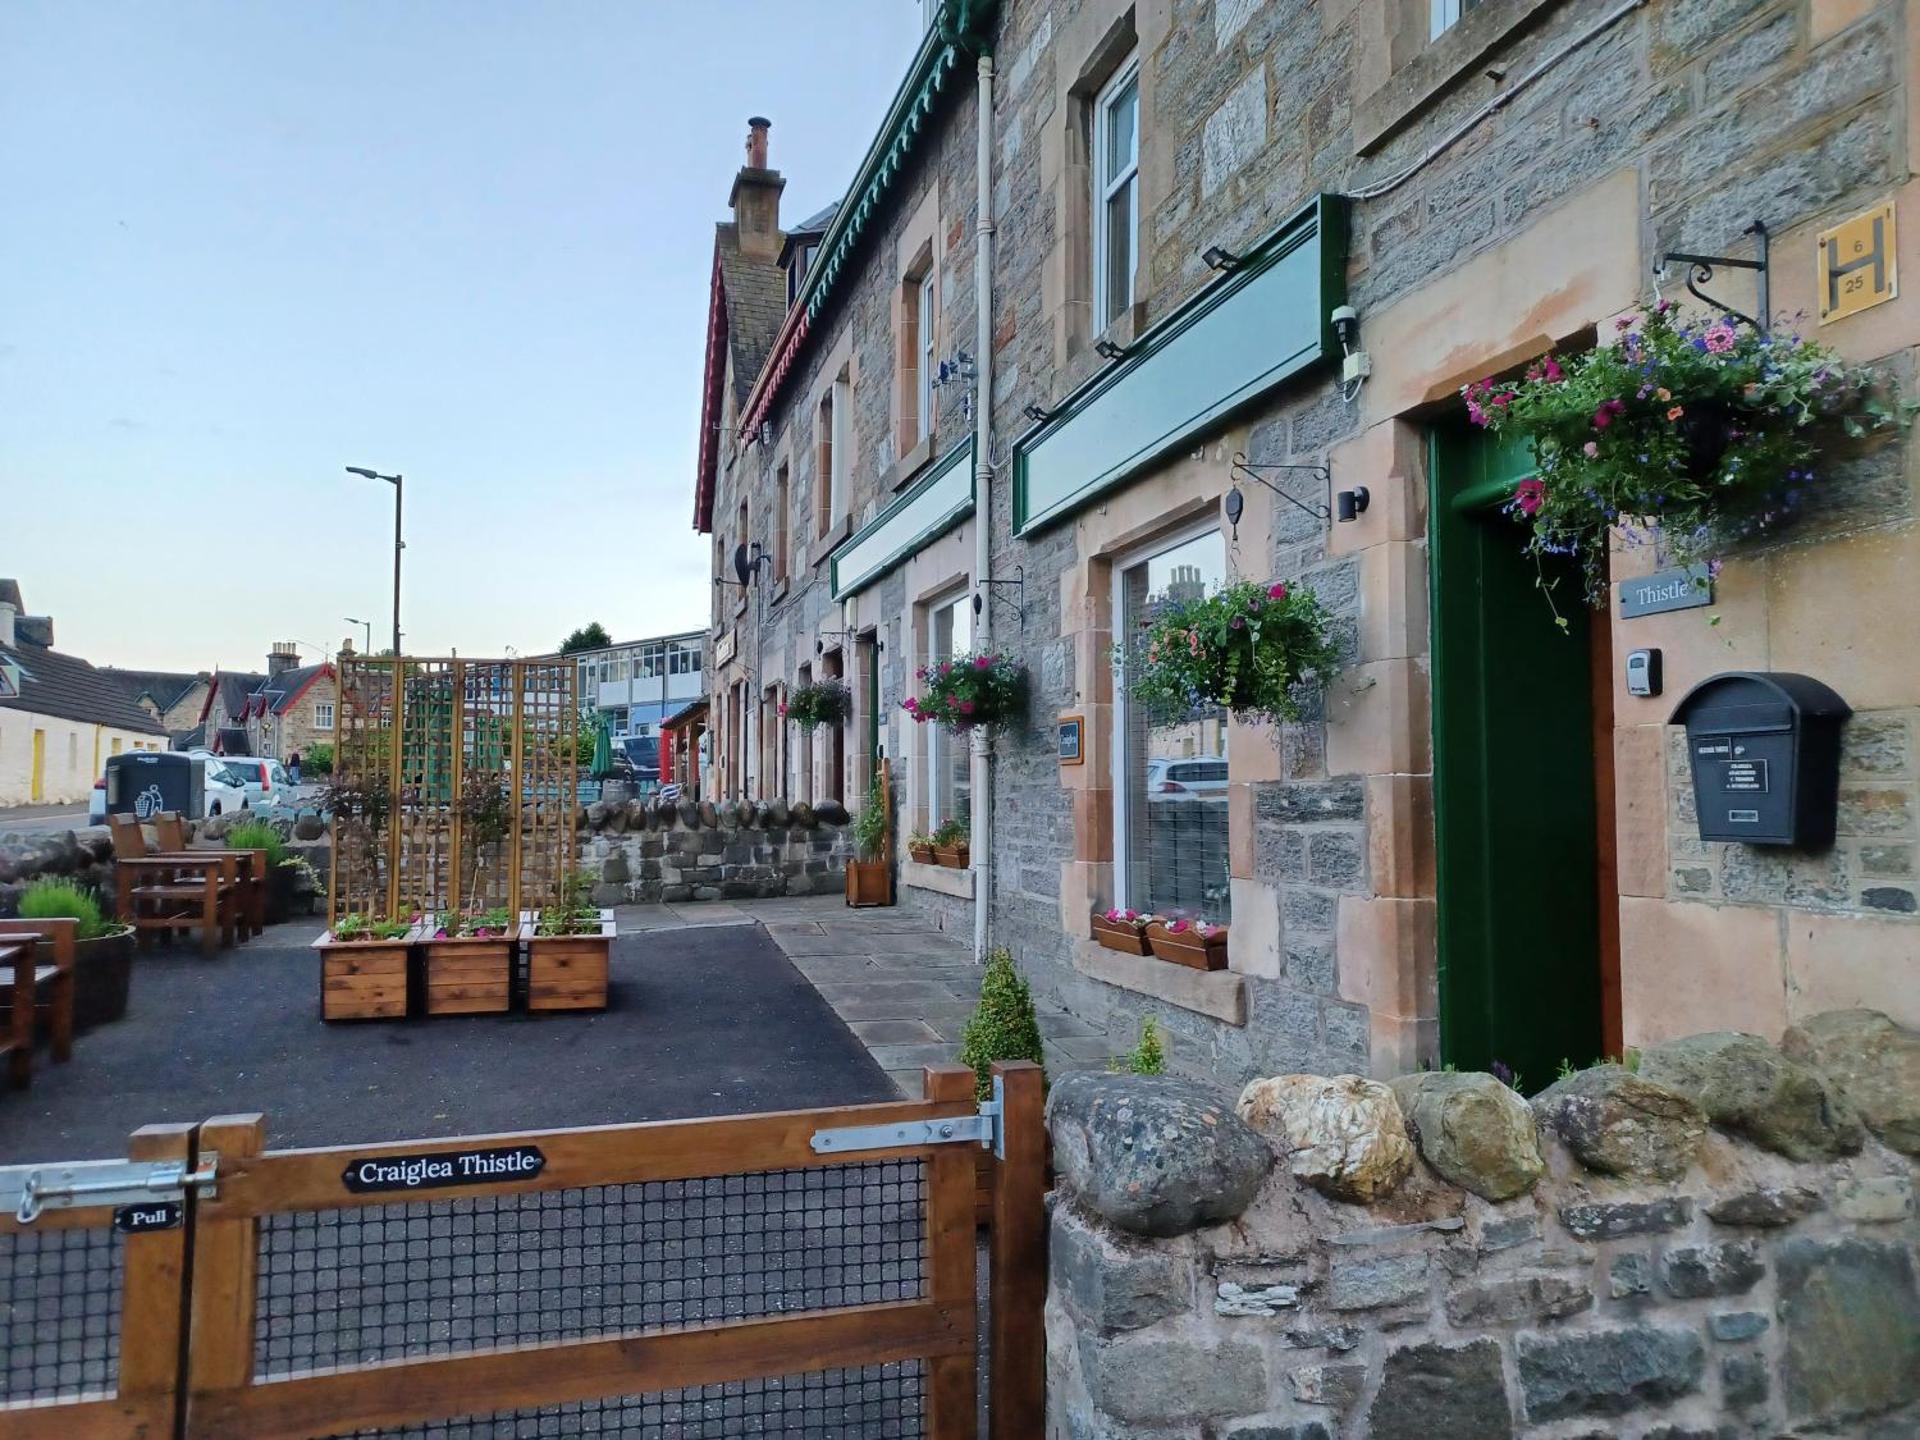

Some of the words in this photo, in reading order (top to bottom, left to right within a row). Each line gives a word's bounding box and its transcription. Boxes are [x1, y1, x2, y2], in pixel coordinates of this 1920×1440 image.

[1854, 240, 1863, 253] 6
[1828, 215, 1885, 313] H
[1845, 276, 1864, 294] 25
[1636, 579, 1689, 605] Thistle
[359, 1158, 453, 1185] Craiglea
[458, 1151, 534, 1176] Thistle
[131, 1209, 166, 1226] Pull
